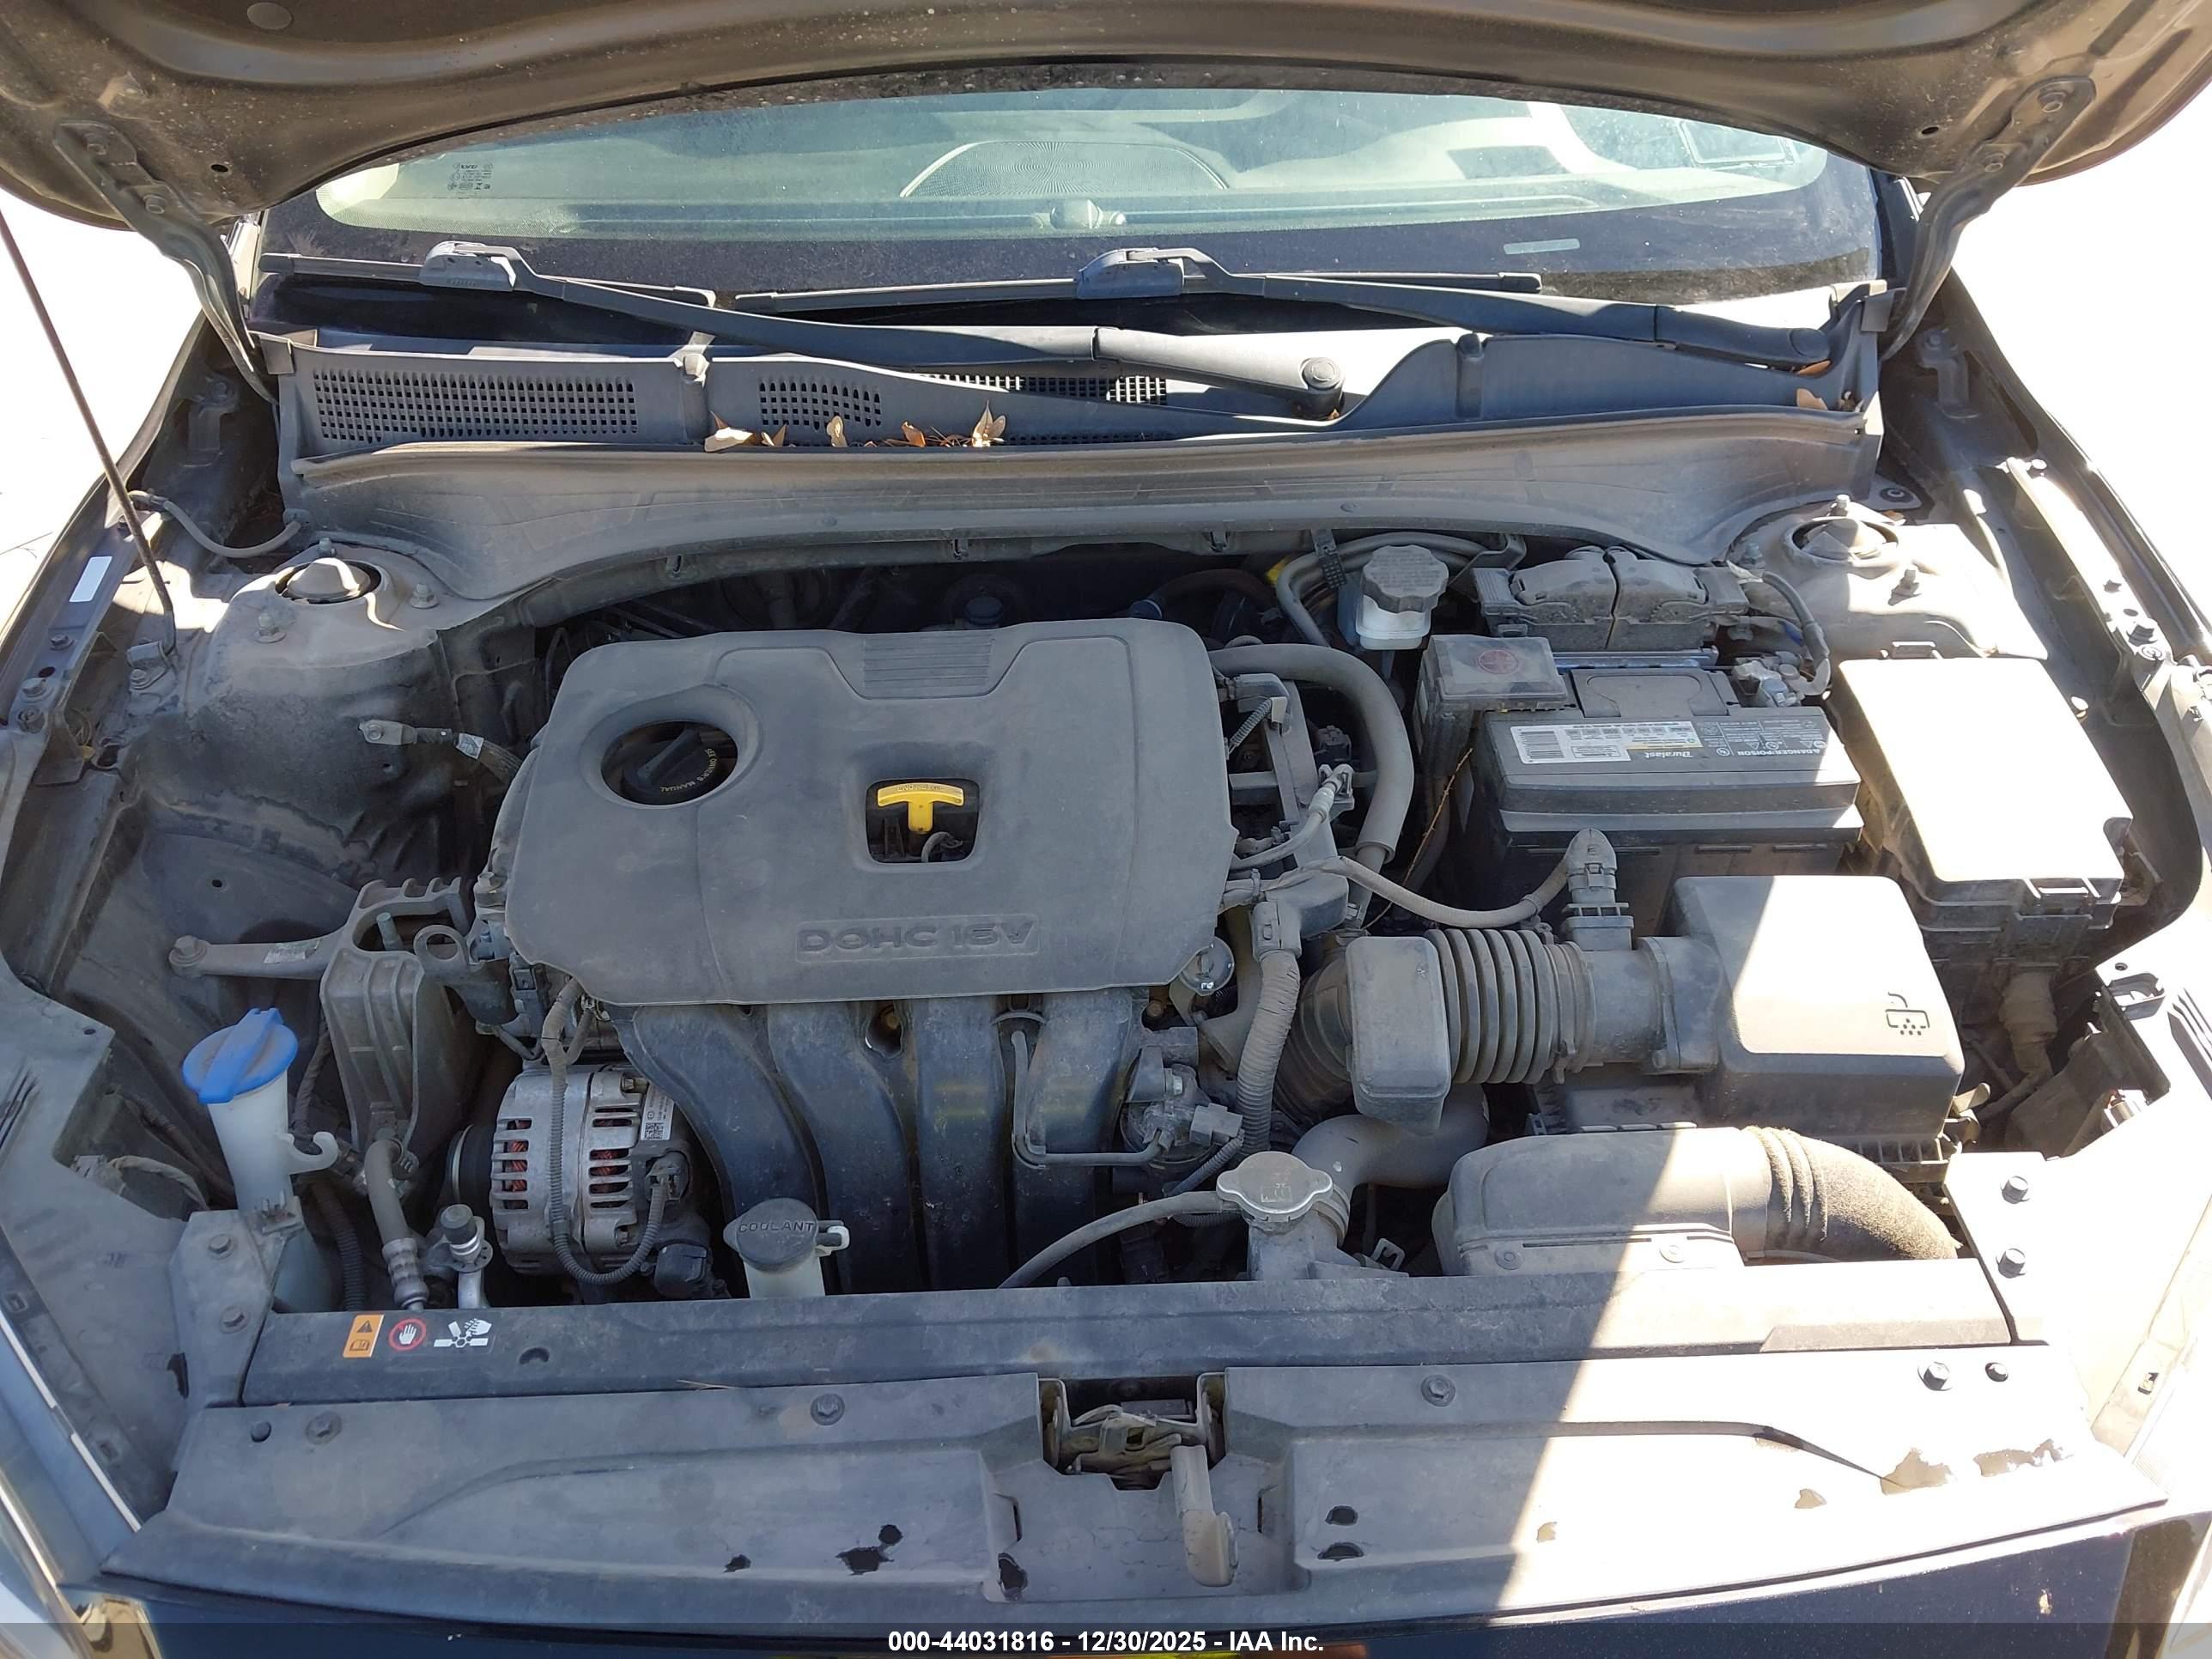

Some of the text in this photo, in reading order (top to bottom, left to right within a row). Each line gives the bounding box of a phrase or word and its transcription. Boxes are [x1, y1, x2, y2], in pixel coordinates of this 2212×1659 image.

[1644, 750, 1694, 759] Duralast
[659, 781, 696, 792] MANUAL
[799, 921, 1035, 951] DOHC 16V
[738, 1221, 815, 1233] COOLANT
